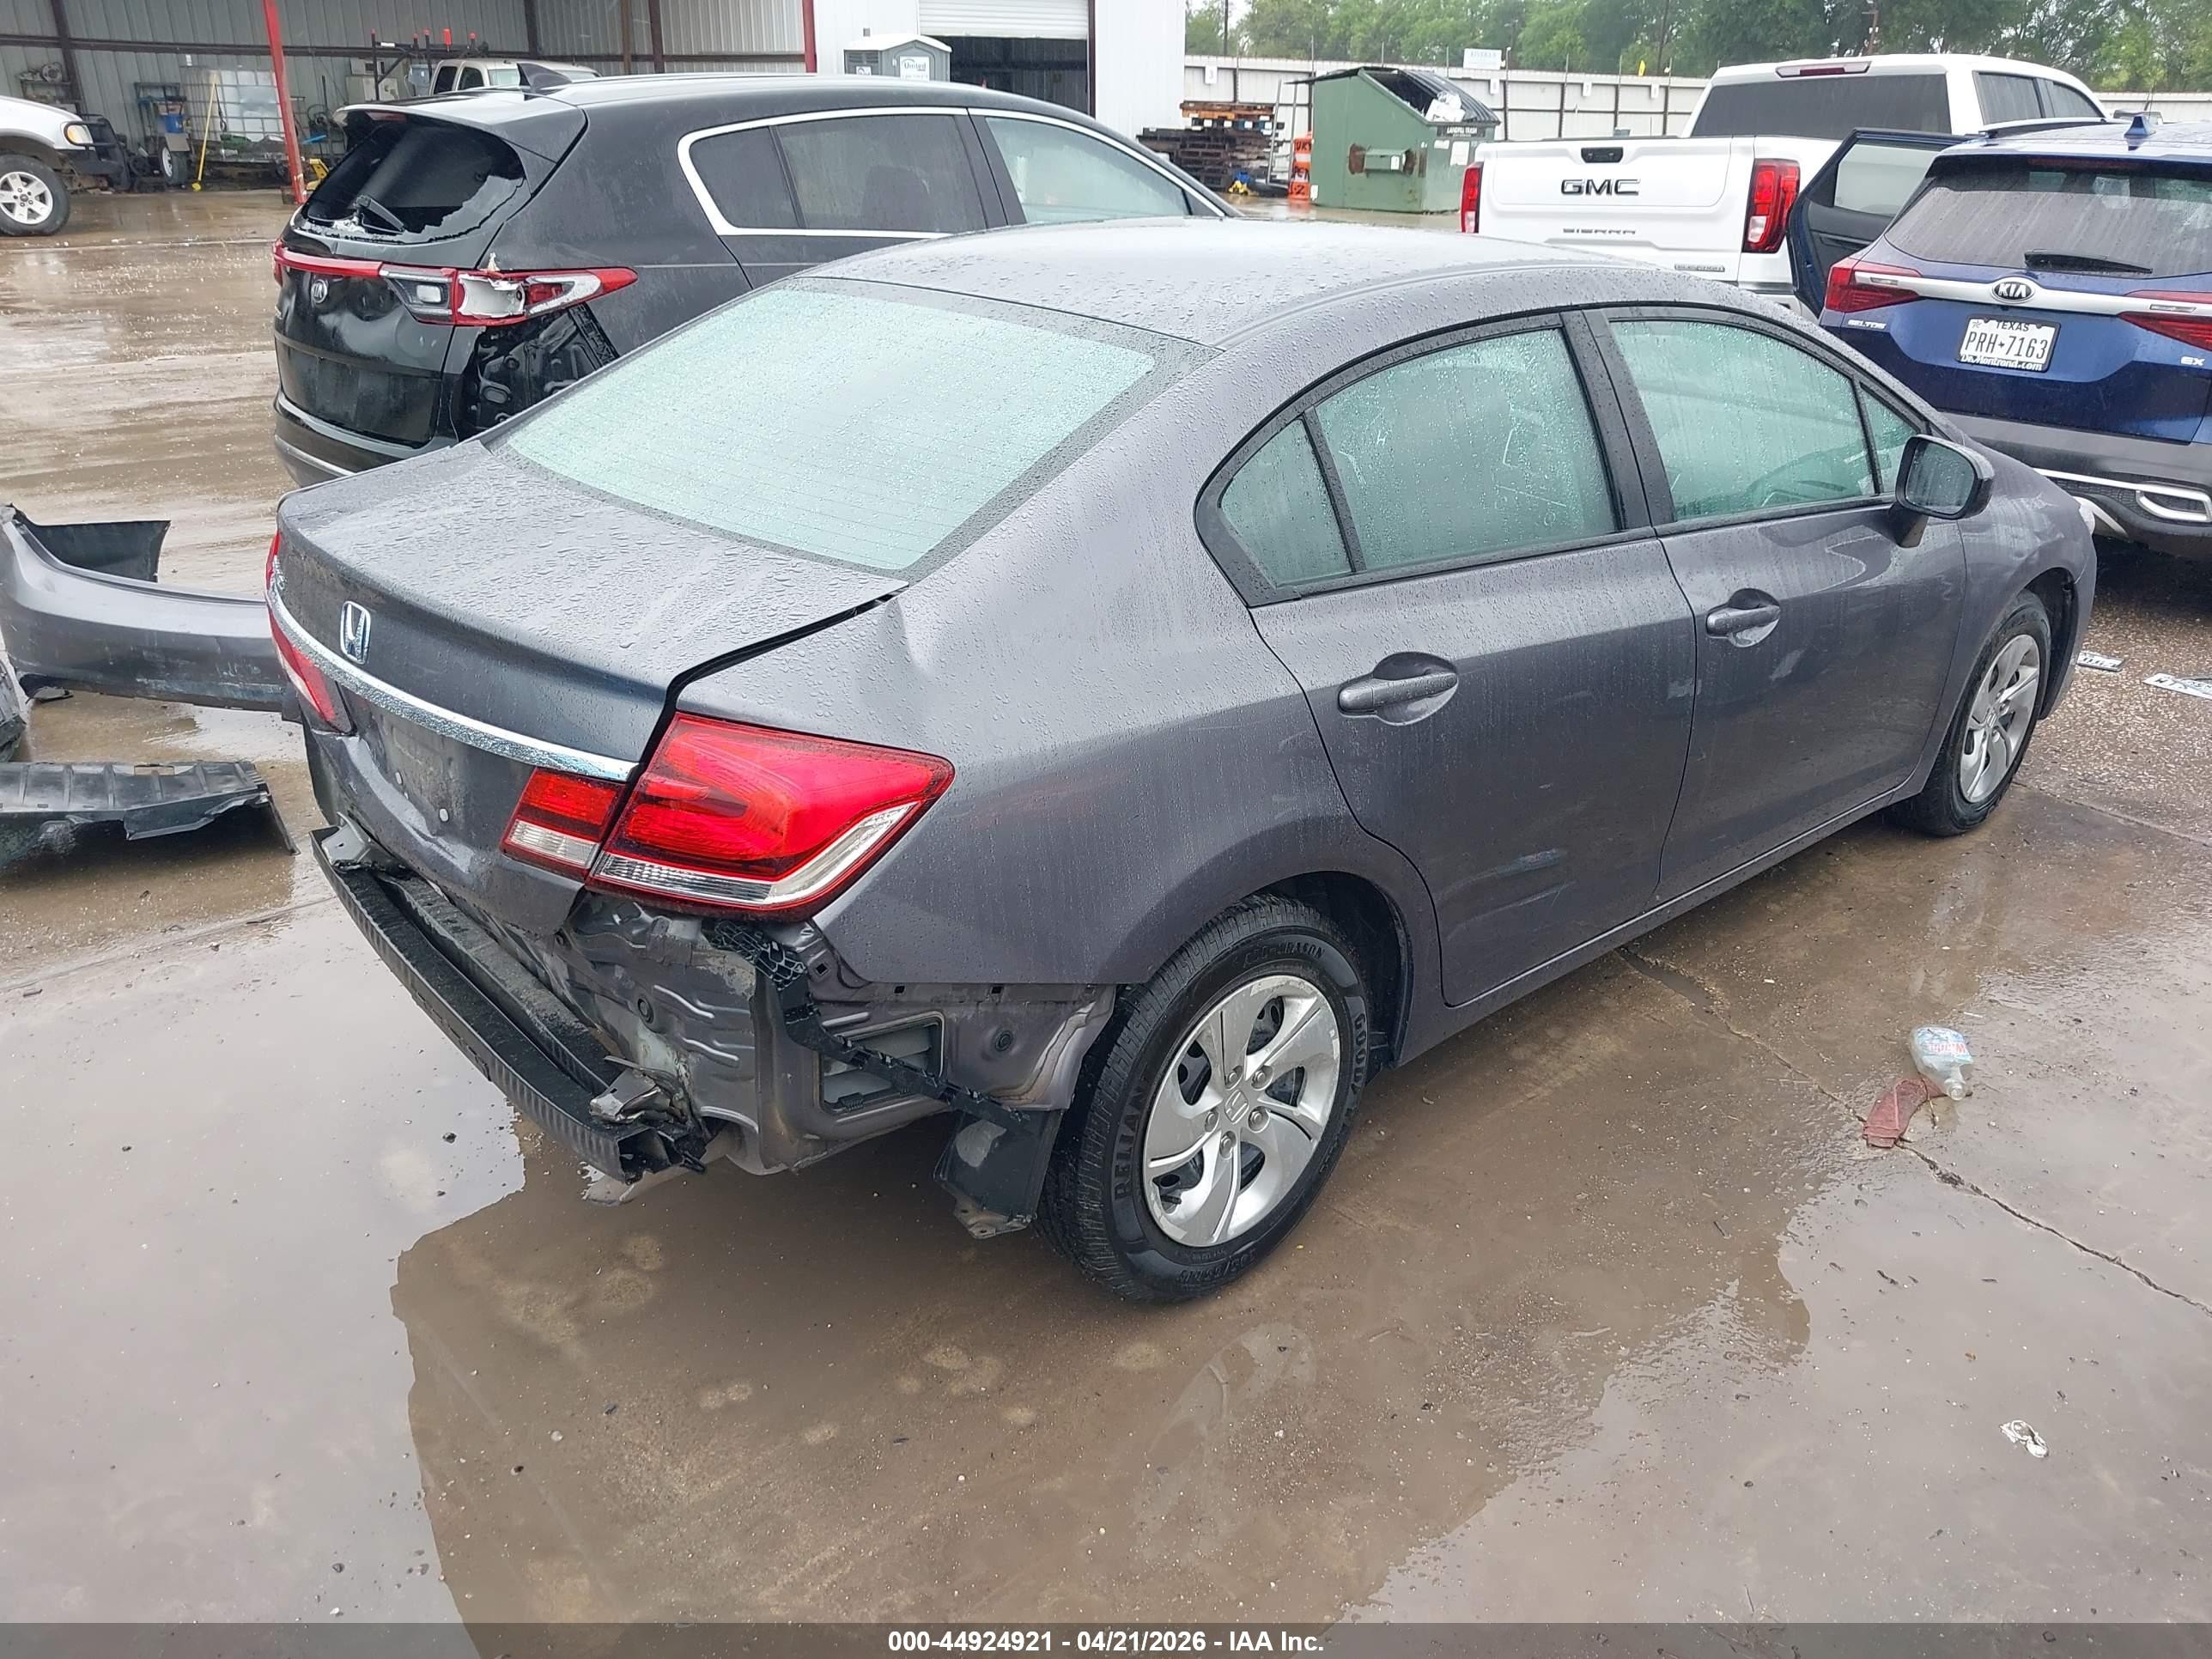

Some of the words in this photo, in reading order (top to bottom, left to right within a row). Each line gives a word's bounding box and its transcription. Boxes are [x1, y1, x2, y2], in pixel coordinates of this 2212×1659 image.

[1561, 179, 1640, 196] GMC
[1997, 283, 2027, 298] KIA
[1996, 321, 2030, 332] TEXAS
[2181, 356, 2206, 367] EX
